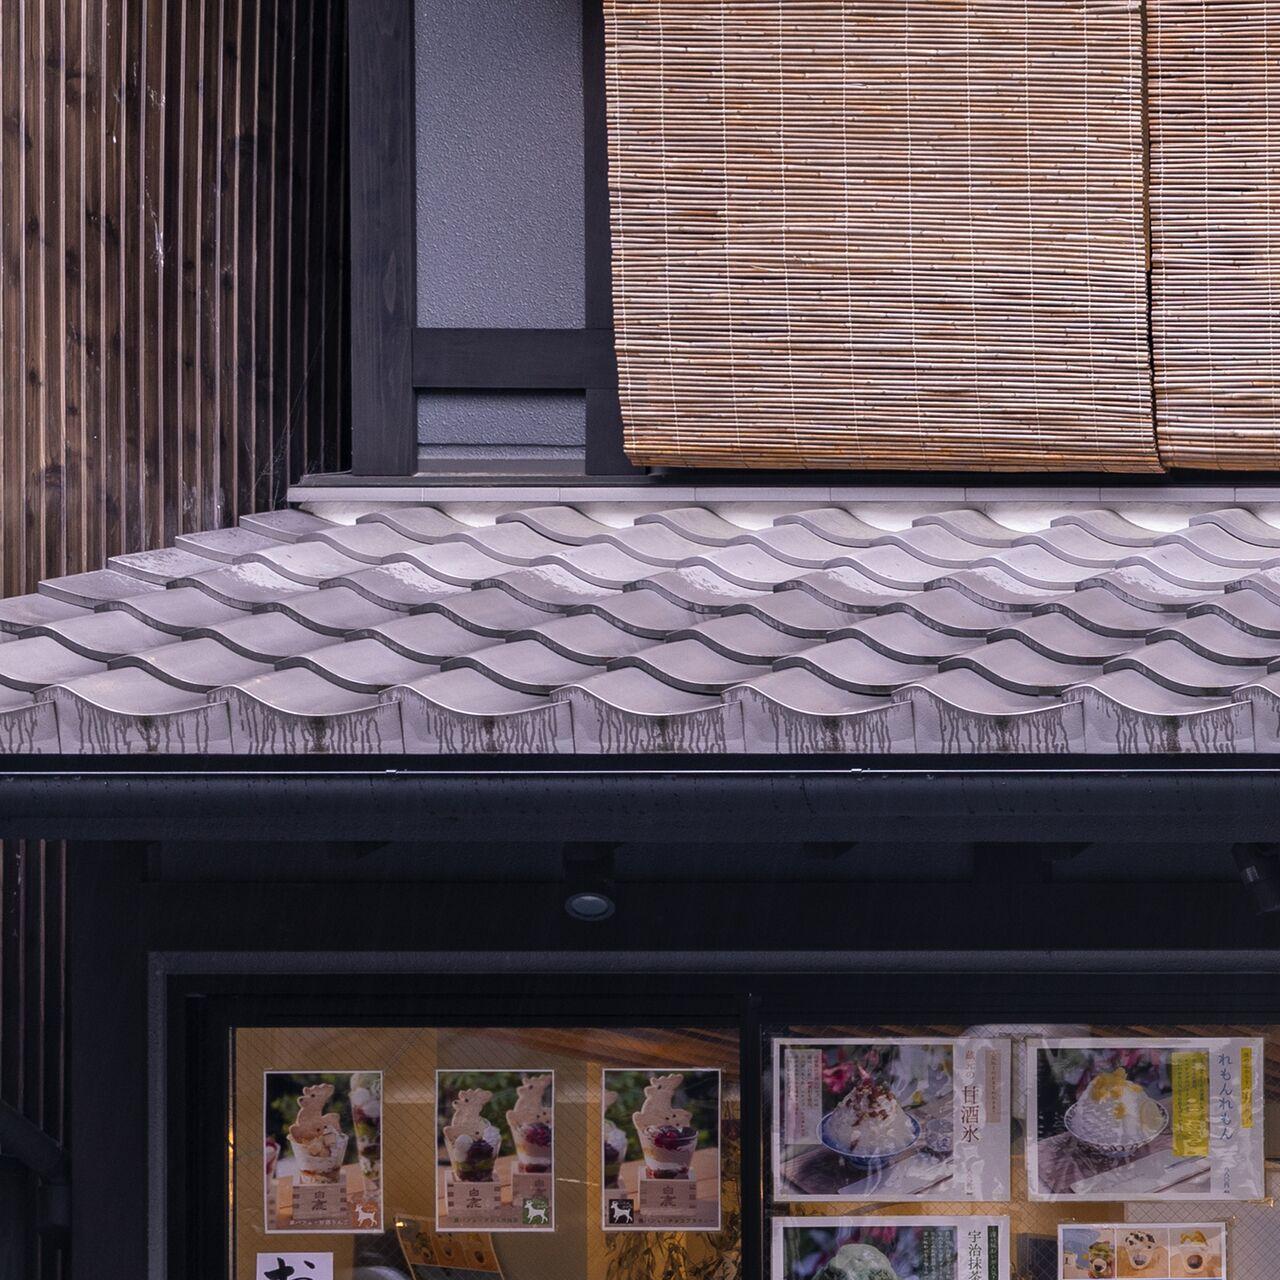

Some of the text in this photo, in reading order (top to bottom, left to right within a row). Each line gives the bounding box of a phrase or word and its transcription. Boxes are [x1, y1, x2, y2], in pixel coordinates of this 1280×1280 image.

[1218, 1053, 1232, 1140] れもんれもん
